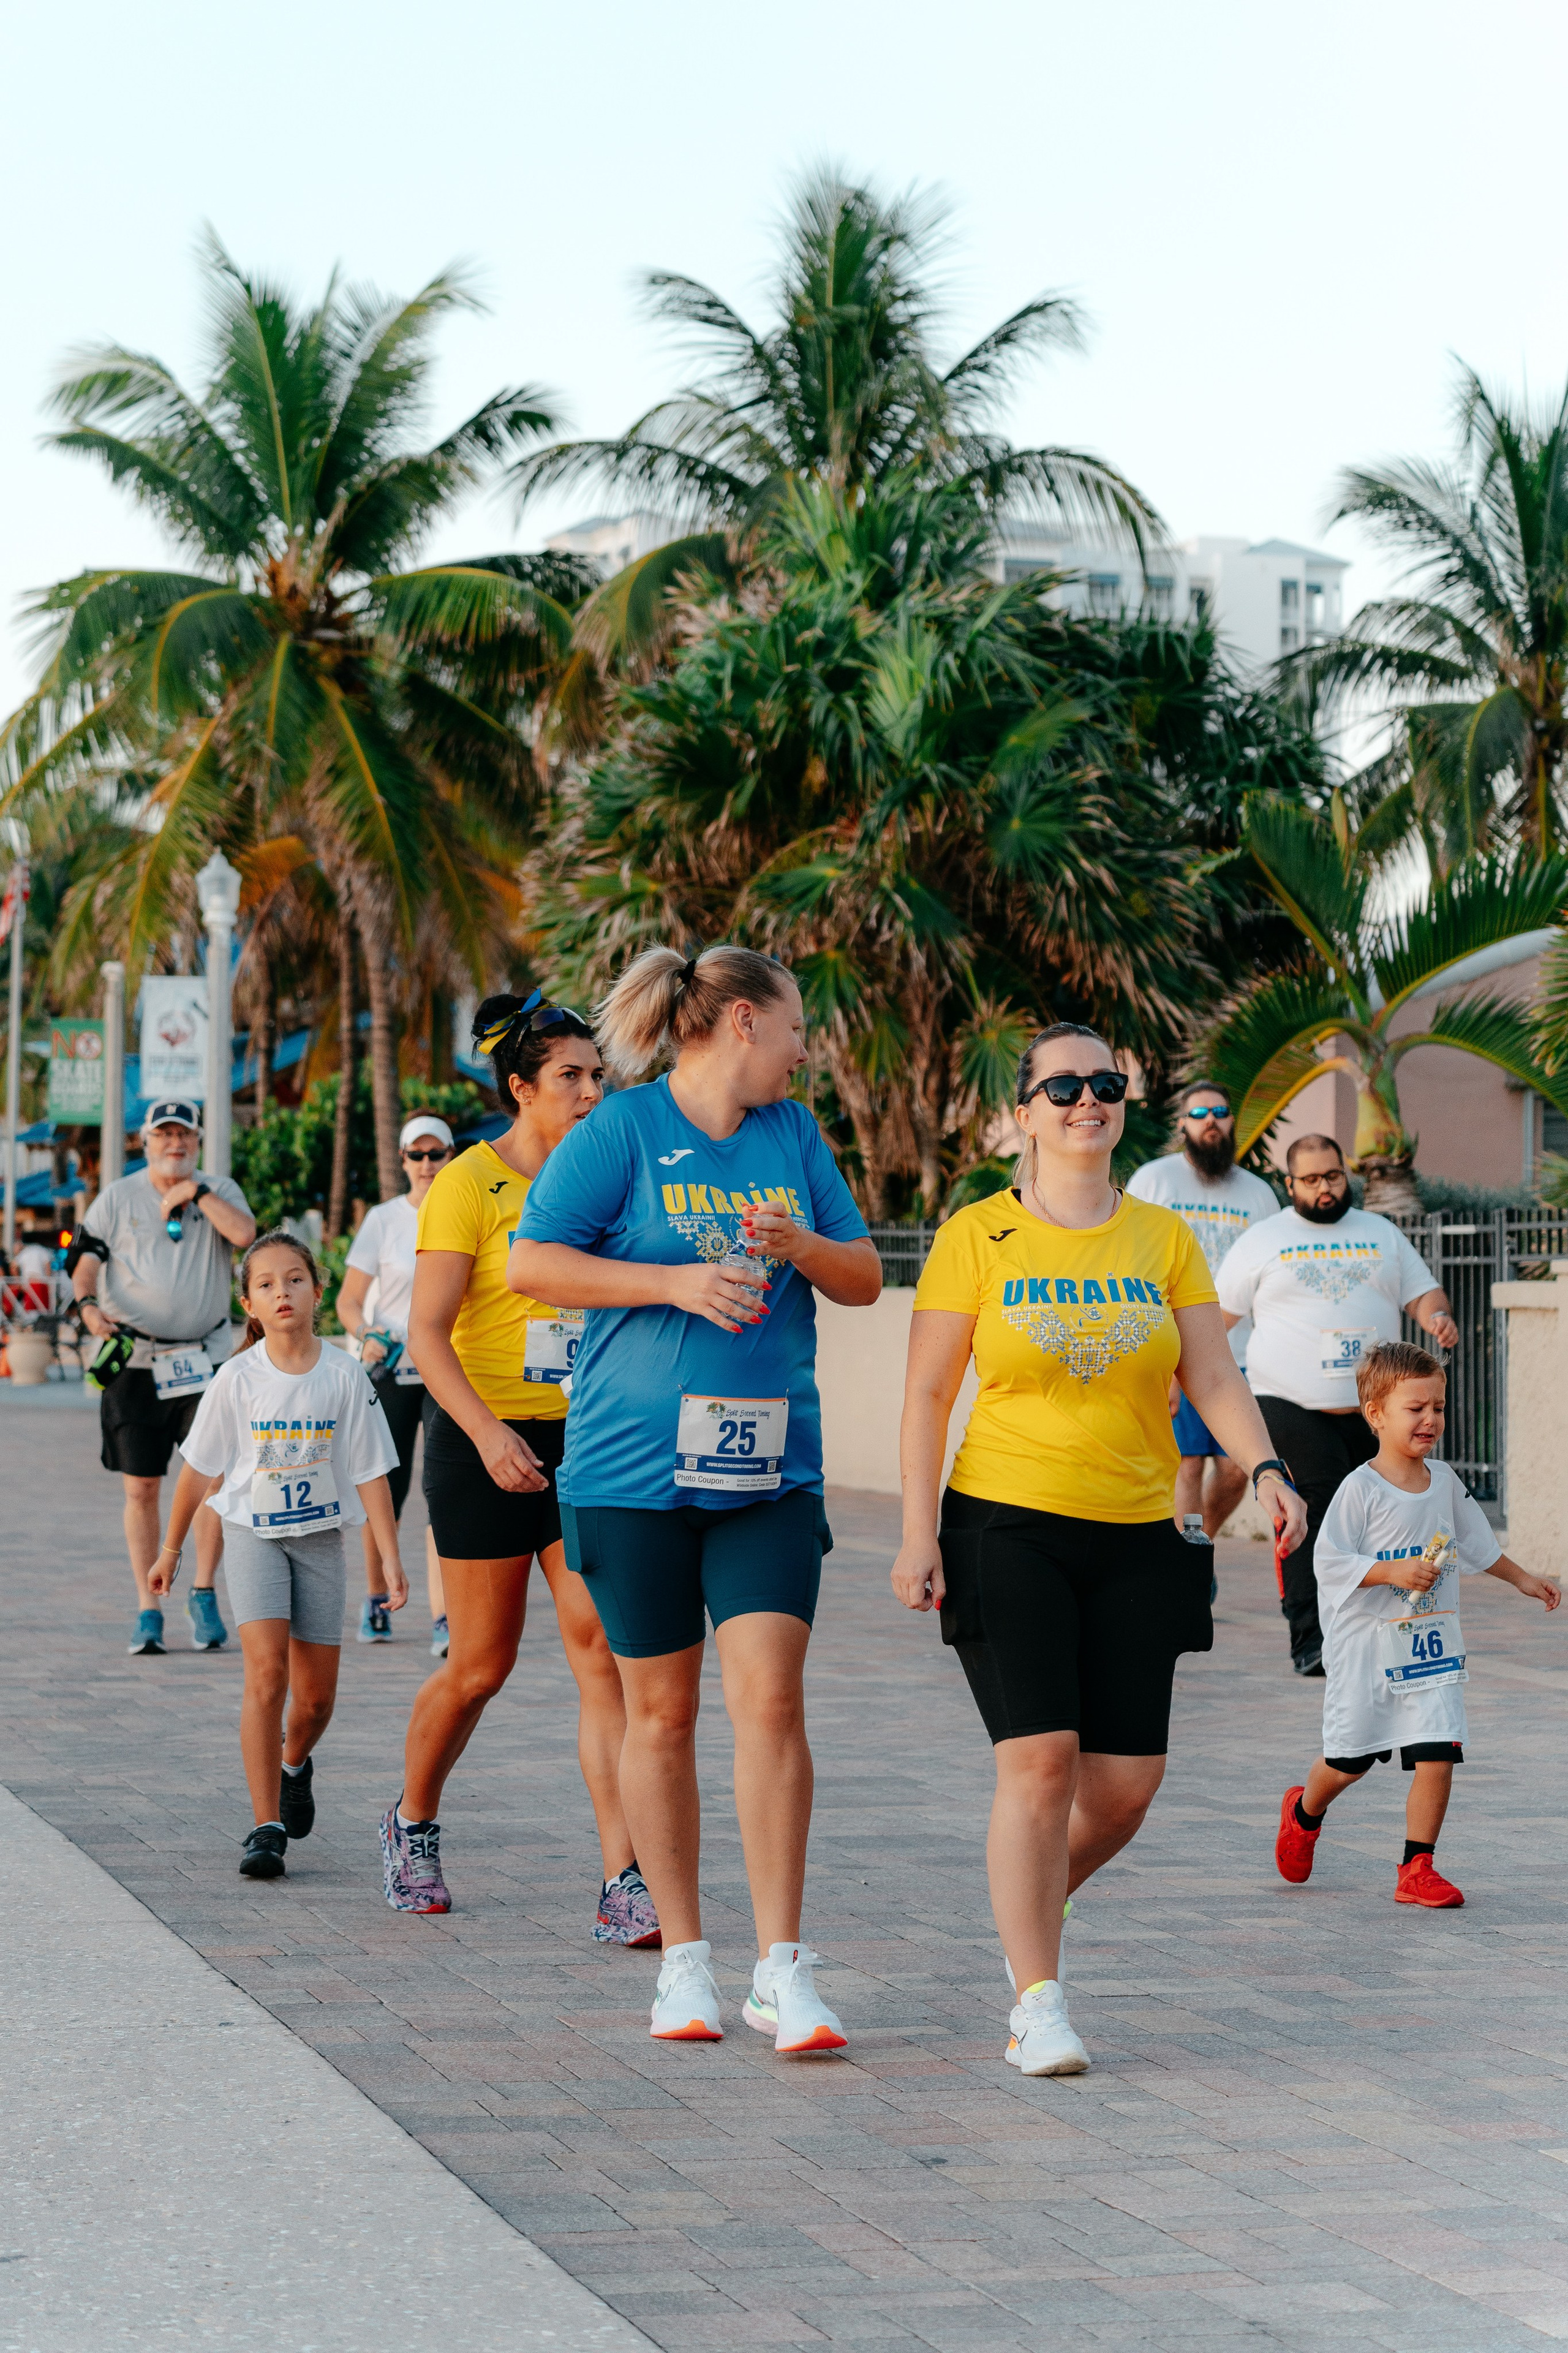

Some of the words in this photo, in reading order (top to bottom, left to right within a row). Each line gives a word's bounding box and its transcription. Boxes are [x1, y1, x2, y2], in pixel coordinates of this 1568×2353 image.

[661, 1182, 805, 1217] UKRAINE
[1280, 1239, 1383, 1262] UKRAINE
[1003, 1272, 1163, 1307] UKRAINE
[1341, 1340, 1360, 1357] 38
[173, 1359, 192, 1377] 64
[726, 1410, 738, 1418] Split
[758, 1410, 770, 1419] Timing
[251, 1416, 336, 1441] UKRAINE
[716, 1419, 757, 1456] 25
[677, 1473, 696, 1482] Photo
[698, 1476, 724, 1485] Coupon
[281, 1481, 312, 1509] 12
[1412, 1630, 1444, 1661] 46
